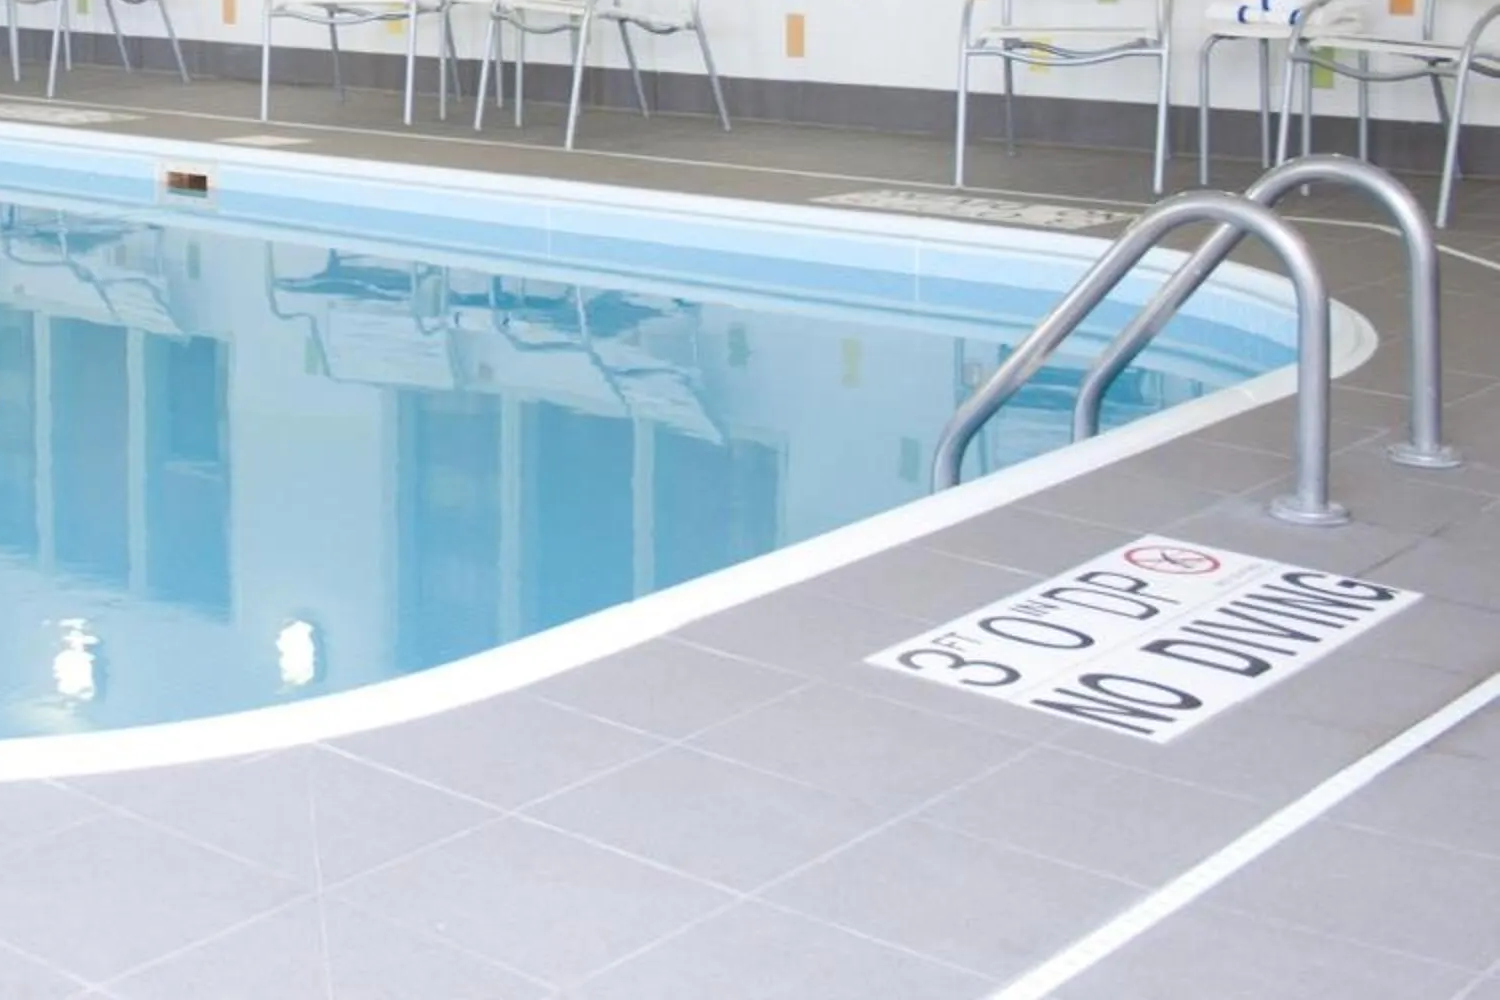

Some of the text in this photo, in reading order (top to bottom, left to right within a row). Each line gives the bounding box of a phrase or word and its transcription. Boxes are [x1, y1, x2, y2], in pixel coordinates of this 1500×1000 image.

[1038, 571, 1182, 621] DP
[1030, 571, 1396, 735] NO DIVING
